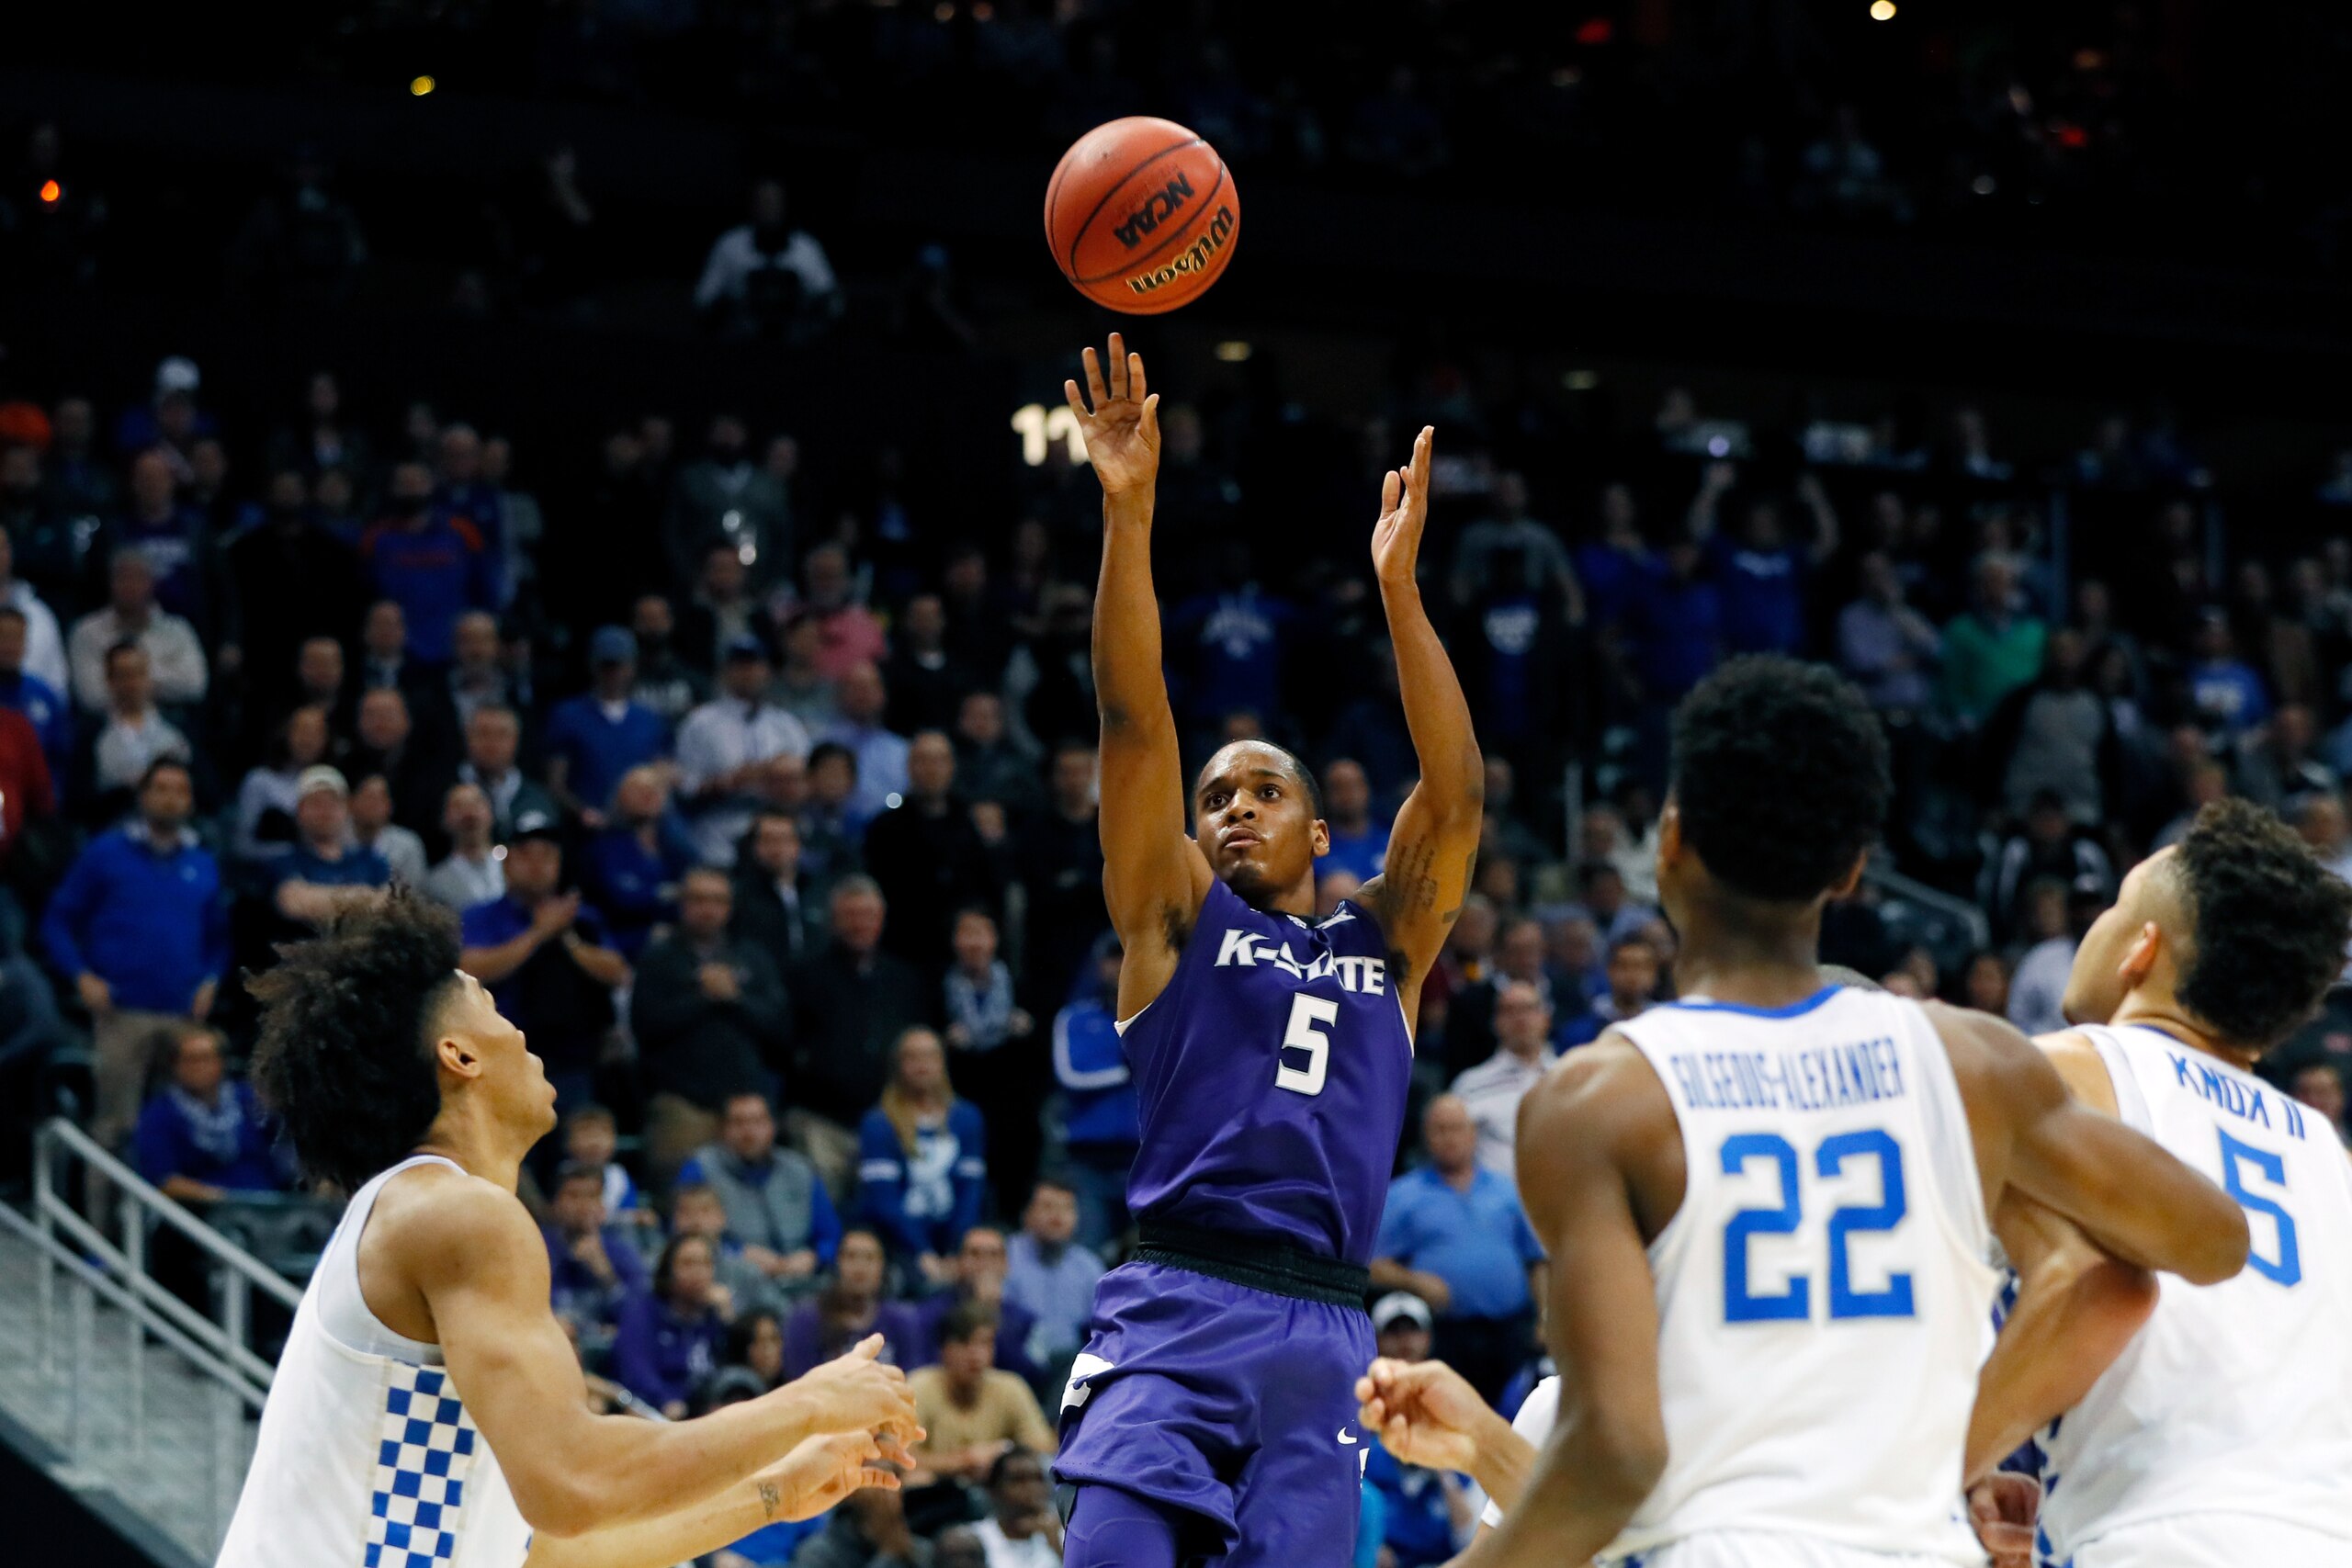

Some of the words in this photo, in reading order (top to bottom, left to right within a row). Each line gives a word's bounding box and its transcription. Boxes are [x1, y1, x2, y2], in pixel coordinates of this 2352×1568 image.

[1113, 171, 1194, 250] NCAA
[1125, 205, 1235, 295] Wilson
[1275, 992, 1339, 1096] 5
[2166, 1052, 2270, 1129] KNOX
[1720, 1129, 1916, 1324] 22
[2216, 1124, 2301, 1288] 5
